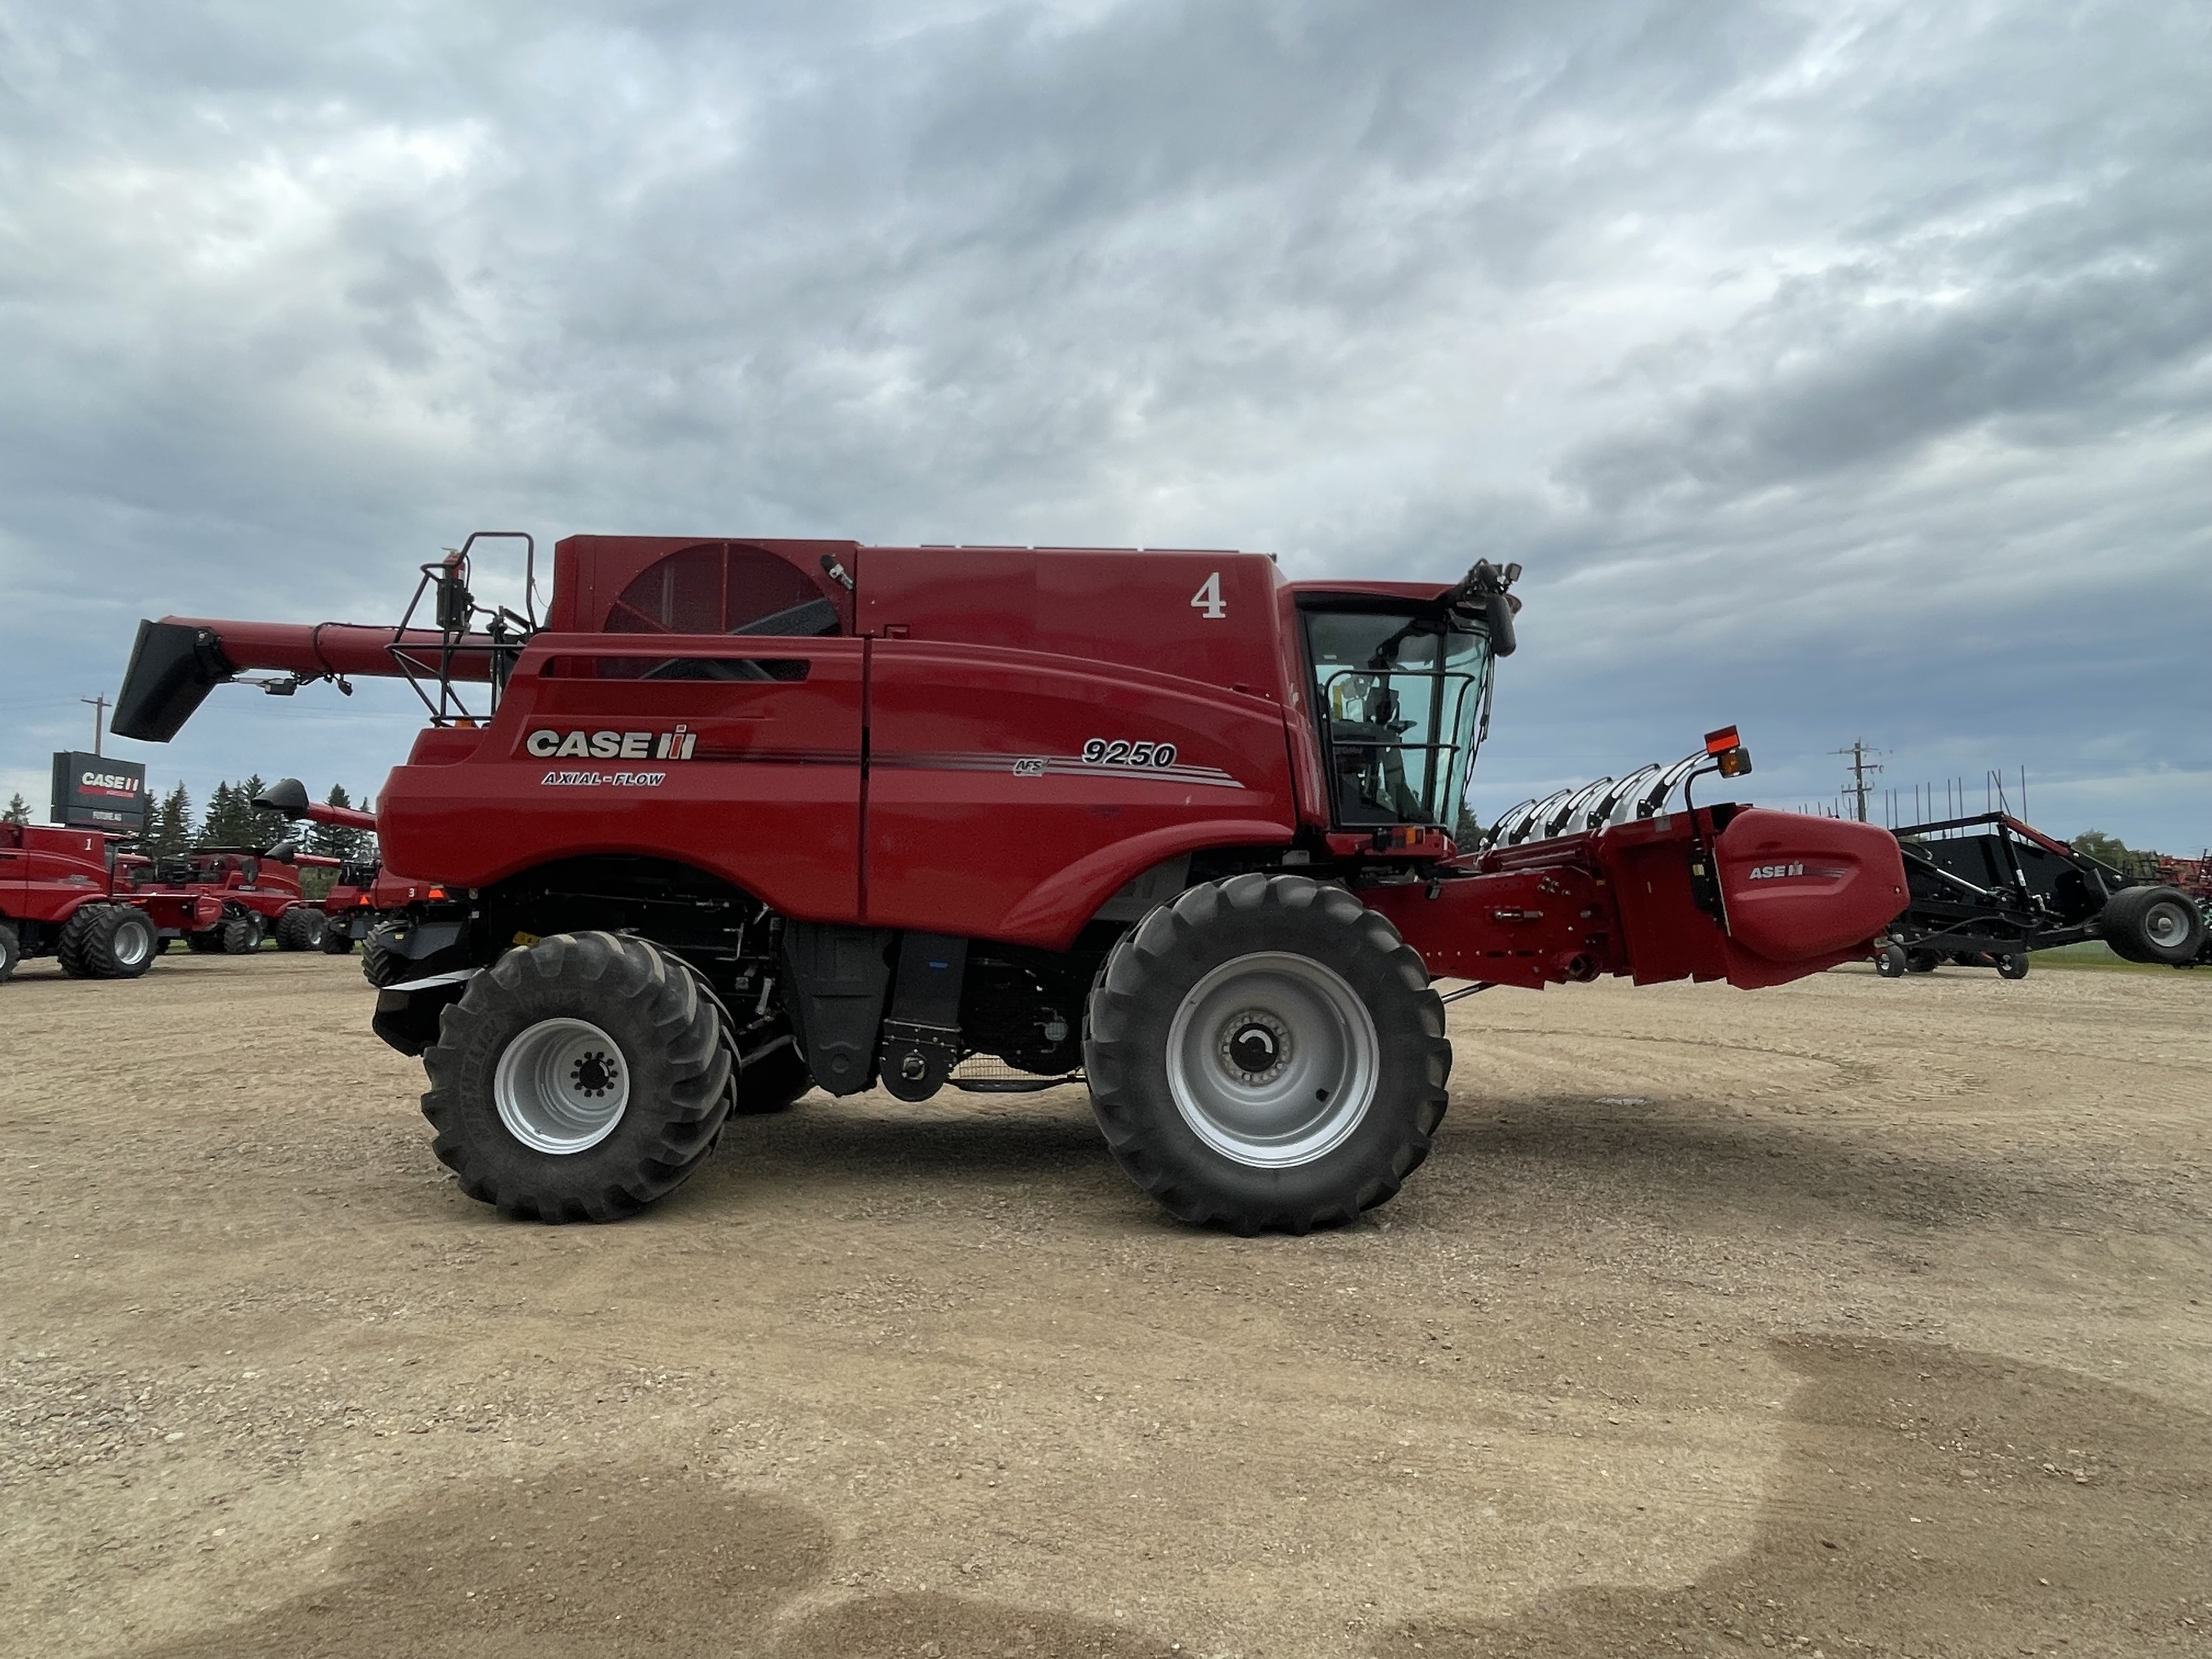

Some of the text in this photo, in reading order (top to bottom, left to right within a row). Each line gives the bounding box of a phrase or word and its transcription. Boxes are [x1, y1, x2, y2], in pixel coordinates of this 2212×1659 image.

[1190, 572, 1227, 618] 4
[527, 730, 652, 758] CASE
[1081, 737, 1178, 768] 9250
[82, 771, 125, 789] CASE
[541, 771, 666, 787] AXIAL-FLOW
[84, 838, 92, 850] 1
[408, 888, 415, 898] 3
